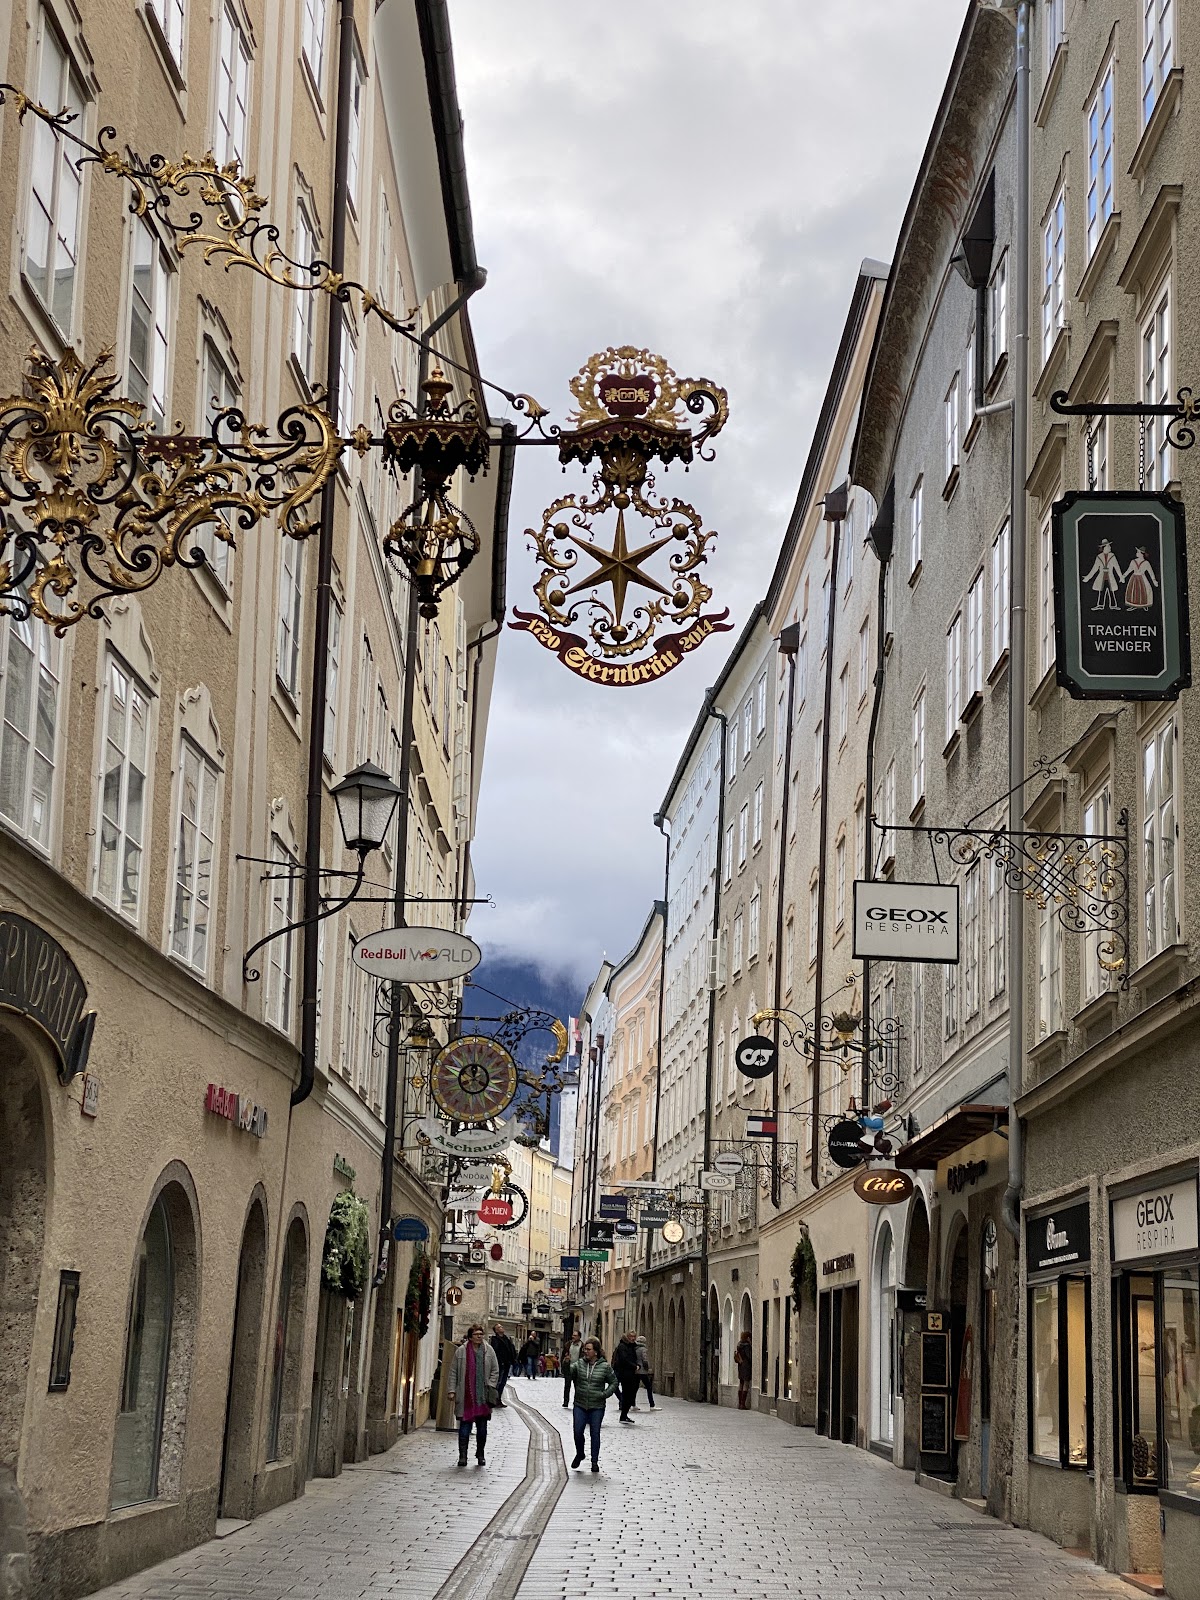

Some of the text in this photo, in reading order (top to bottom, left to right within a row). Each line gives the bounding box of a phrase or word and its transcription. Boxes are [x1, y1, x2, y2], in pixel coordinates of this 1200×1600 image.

[527, 618, 562, 649] 1720
[679, 620, 715, 651] 2014
[1088, 624, 1157, 637] TRACHTEN
[1094, 640, 1151, 652] WENGER
[564, 646, 679, 685] Sternbräu
[866, 907, 948, 924] GEOX
[865, 922, 949, 935] RESPIRA
[409, 947, 473, 963] WORLD
[434, 1134, 508, 1154] Aschauer
[491, 1206, 508, 1215] YUEN
[1136, 1193, 1174, 1228] GEOX
[1136, 1225, 1175, 1251] RESPIRA
